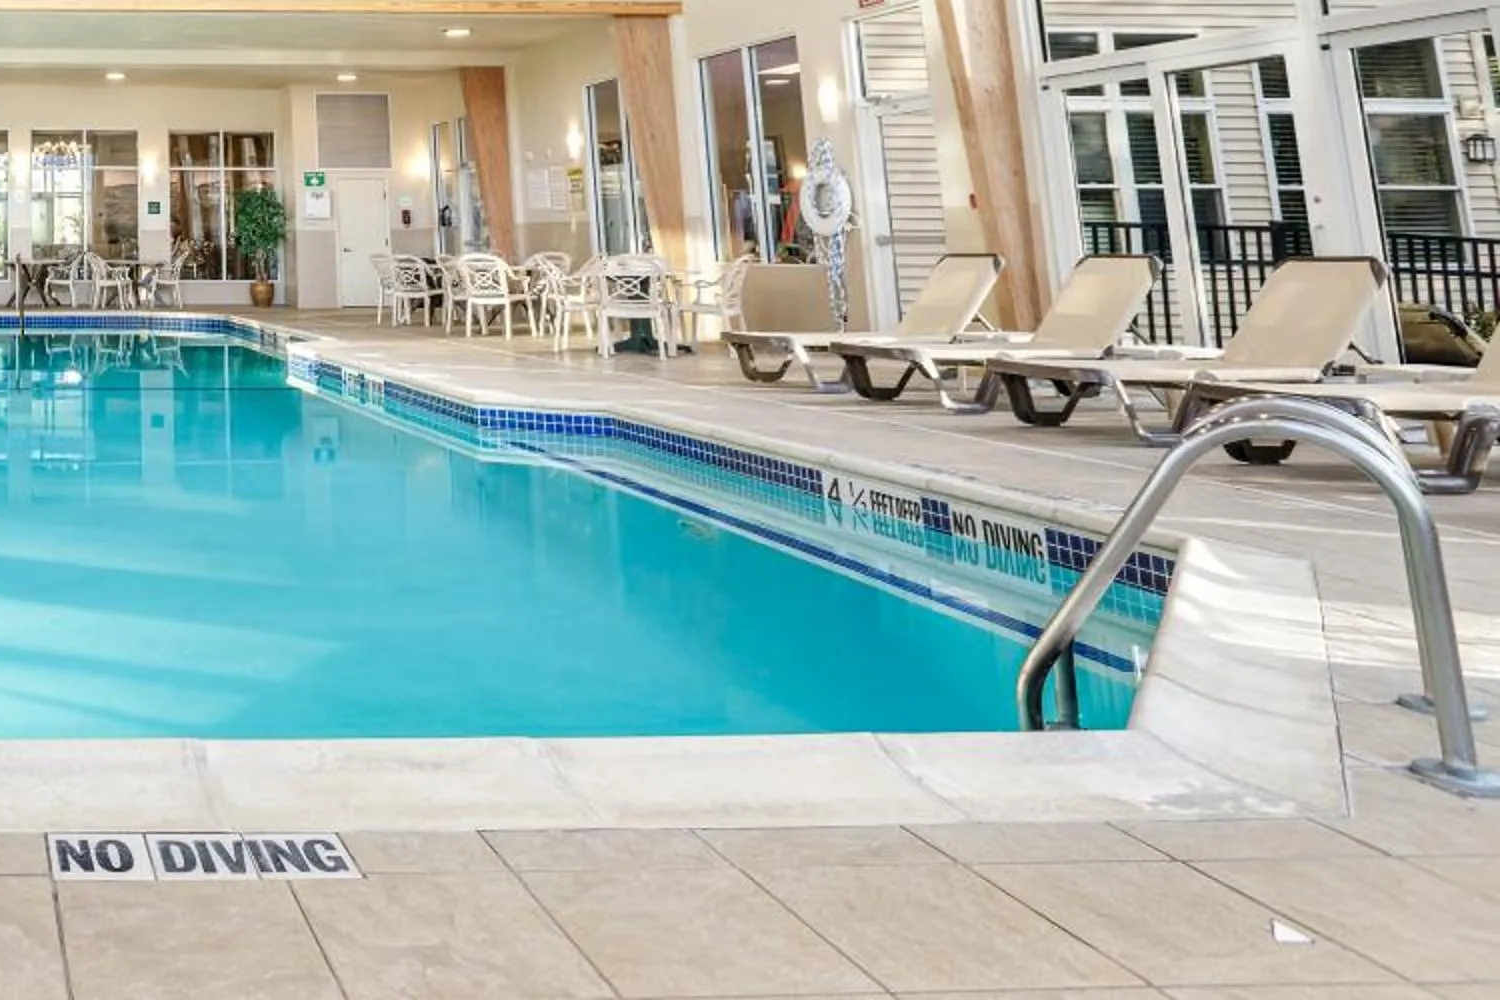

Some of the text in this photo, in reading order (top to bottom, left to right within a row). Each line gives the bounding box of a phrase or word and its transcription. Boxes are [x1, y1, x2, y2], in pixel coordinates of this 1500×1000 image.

[828, 478, 842, 502] 4
[952, 510, 1045, 560] NO DIVING
[55, 839, 350, 874] NO DIVING
